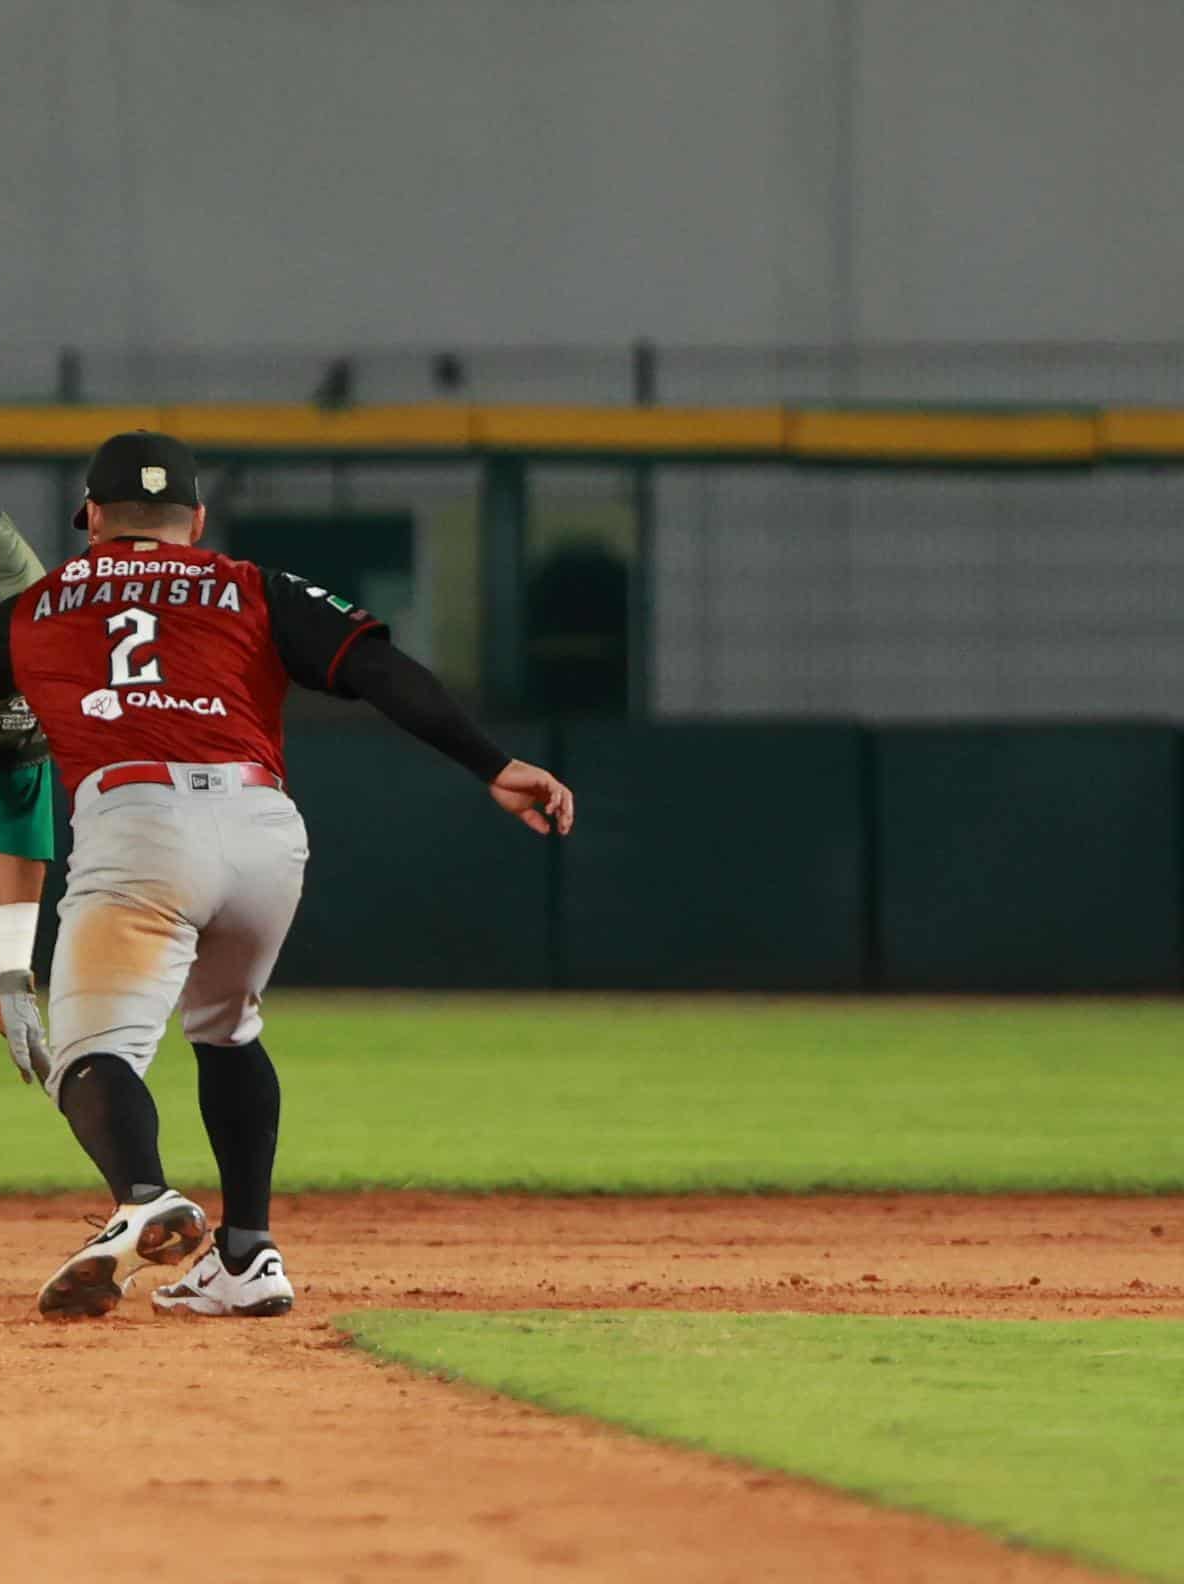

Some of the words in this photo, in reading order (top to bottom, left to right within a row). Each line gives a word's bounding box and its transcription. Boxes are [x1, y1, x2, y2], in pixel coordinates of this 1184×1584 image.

[96, 556, 216, 577] Banamex
[33, 579, 241, 622] AMARISTA
[106, 606, 163, 687] 2
